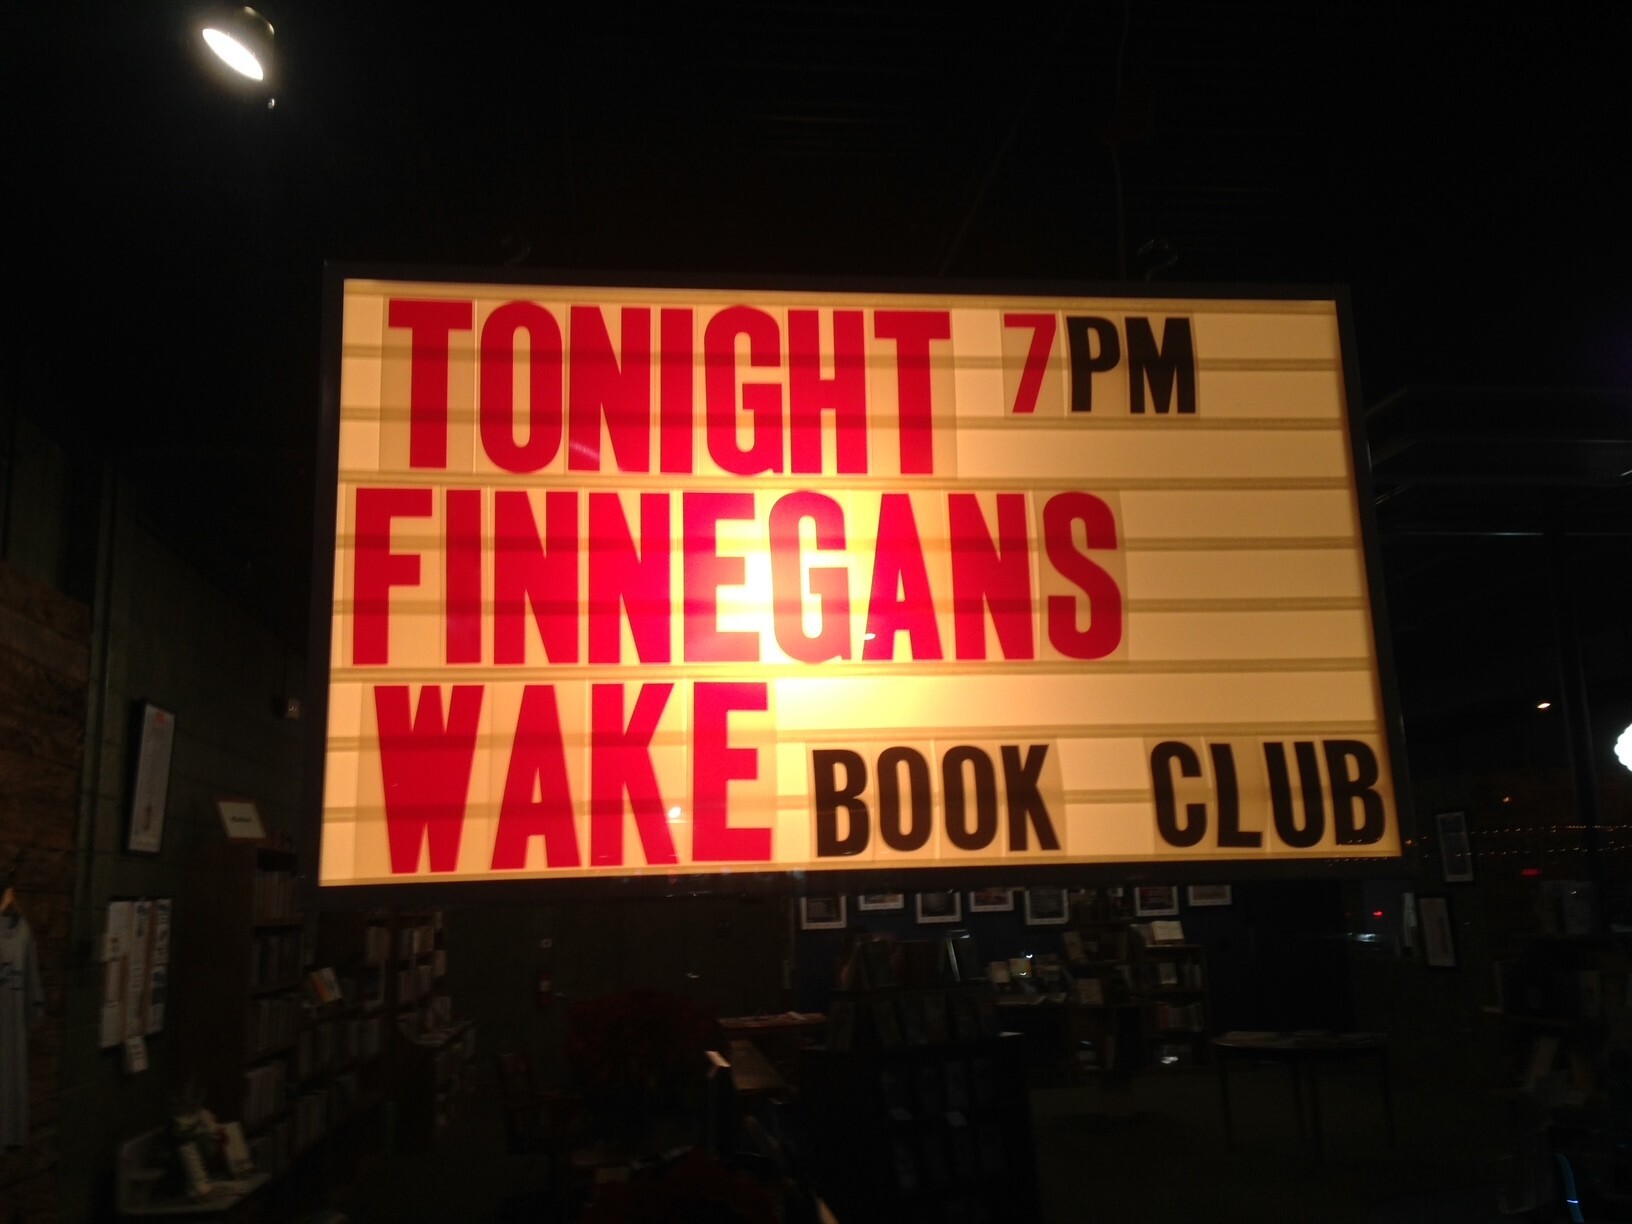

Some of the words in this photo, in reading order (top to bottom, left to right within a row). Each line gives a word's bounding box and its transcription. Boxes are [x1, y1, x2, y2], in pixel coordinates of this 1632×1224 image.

[388, 298, 951, 475] TONIGHT
[352, 488, 1123, 665] FINNEGANS
[373, 682, 773, 874] WAKE
[812, 744, 1061, 857] BOOK
[1150, 740, 1386, 849] CLUB
